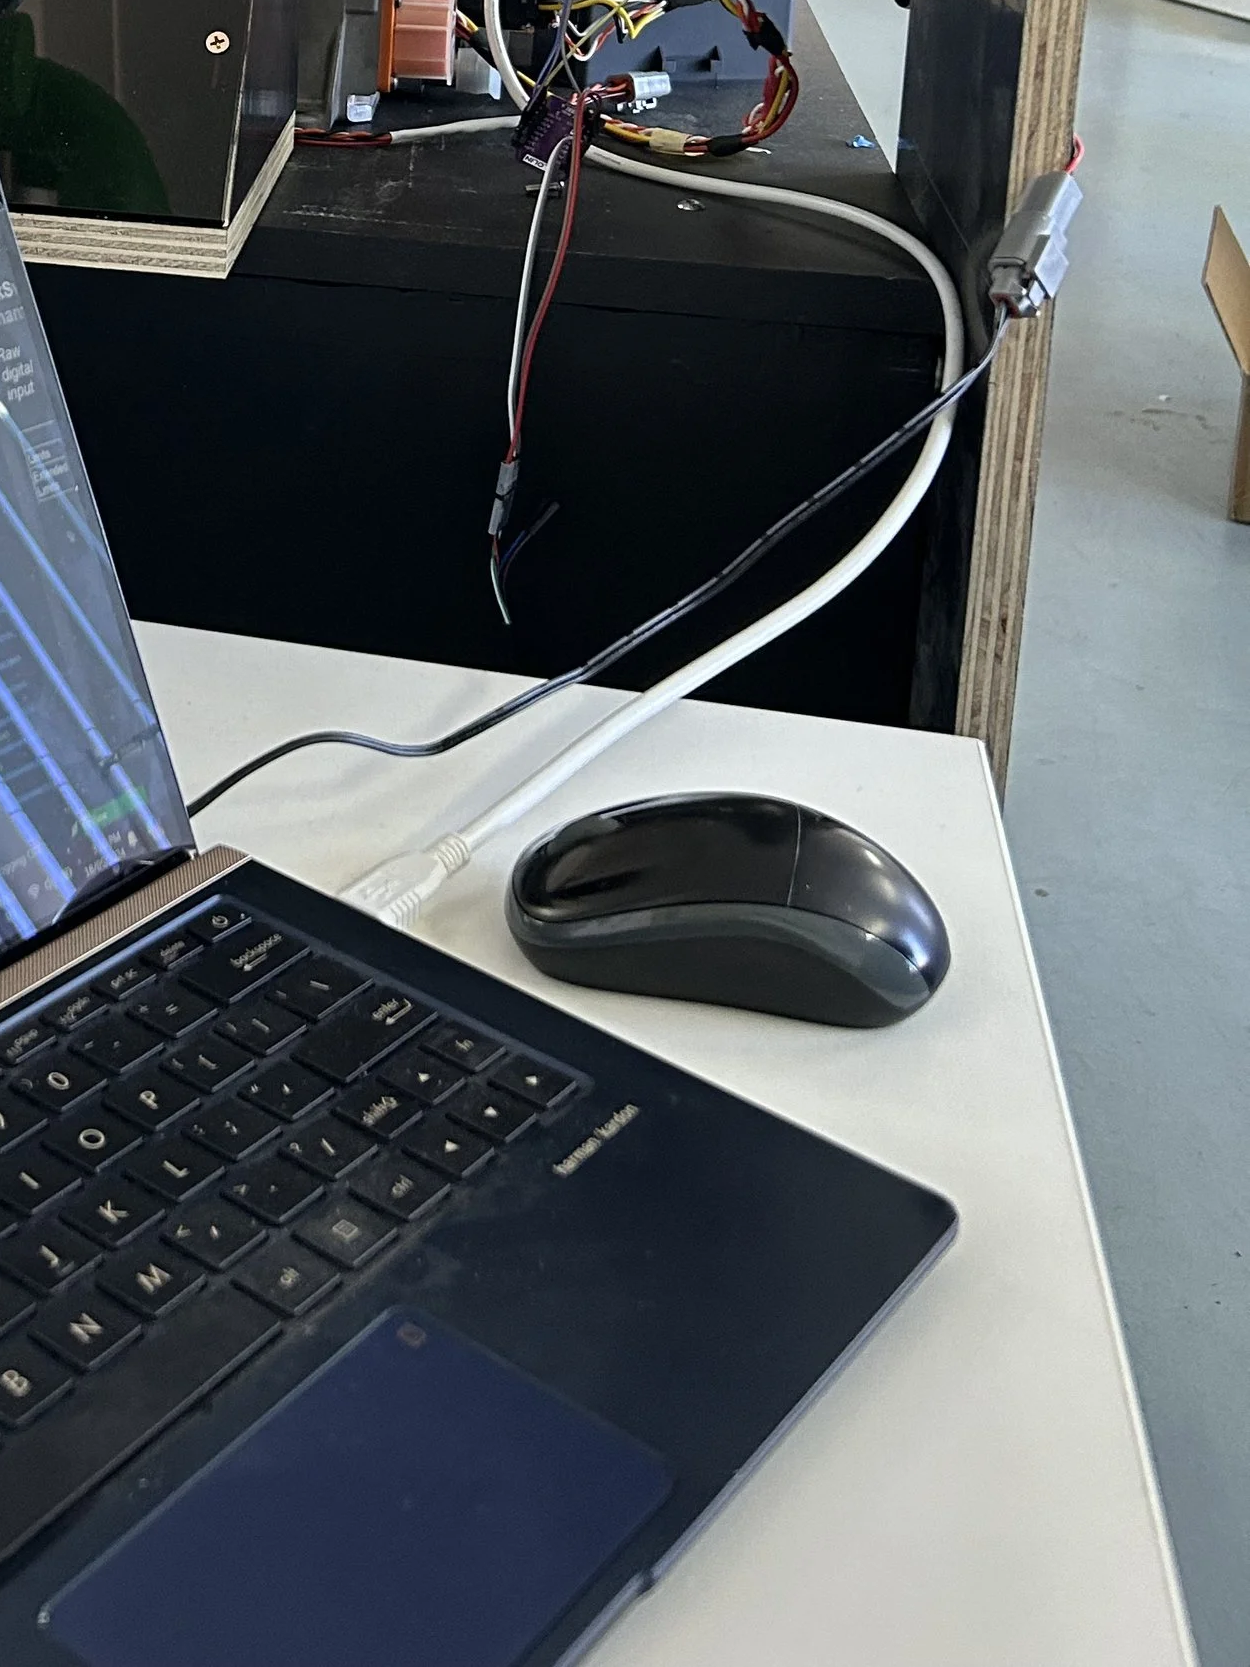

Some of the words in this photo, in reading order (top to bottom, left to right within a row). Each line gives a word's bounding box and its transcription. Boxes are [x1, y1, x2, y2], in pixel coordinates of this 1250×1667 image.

[1, 358, 34, 385] digital
[7, 380, 35, 402] input
[230, 933, 283, 967] backspace
[371, 998, 399, 1022] enter
[138, 1089, 159, 1110] P
[78, 1128, 106, 1150] O
[19, 1170, 41, 1190] I
[162, 1160, 190, 1180] L
[97, 1199, 130, 1224] K
[38, 1244, 60, 1268] J
[136, 1263, 172, 1294] M
[69, 1312, 103, 1344] N
[0, 1369, 32, 1397] B
